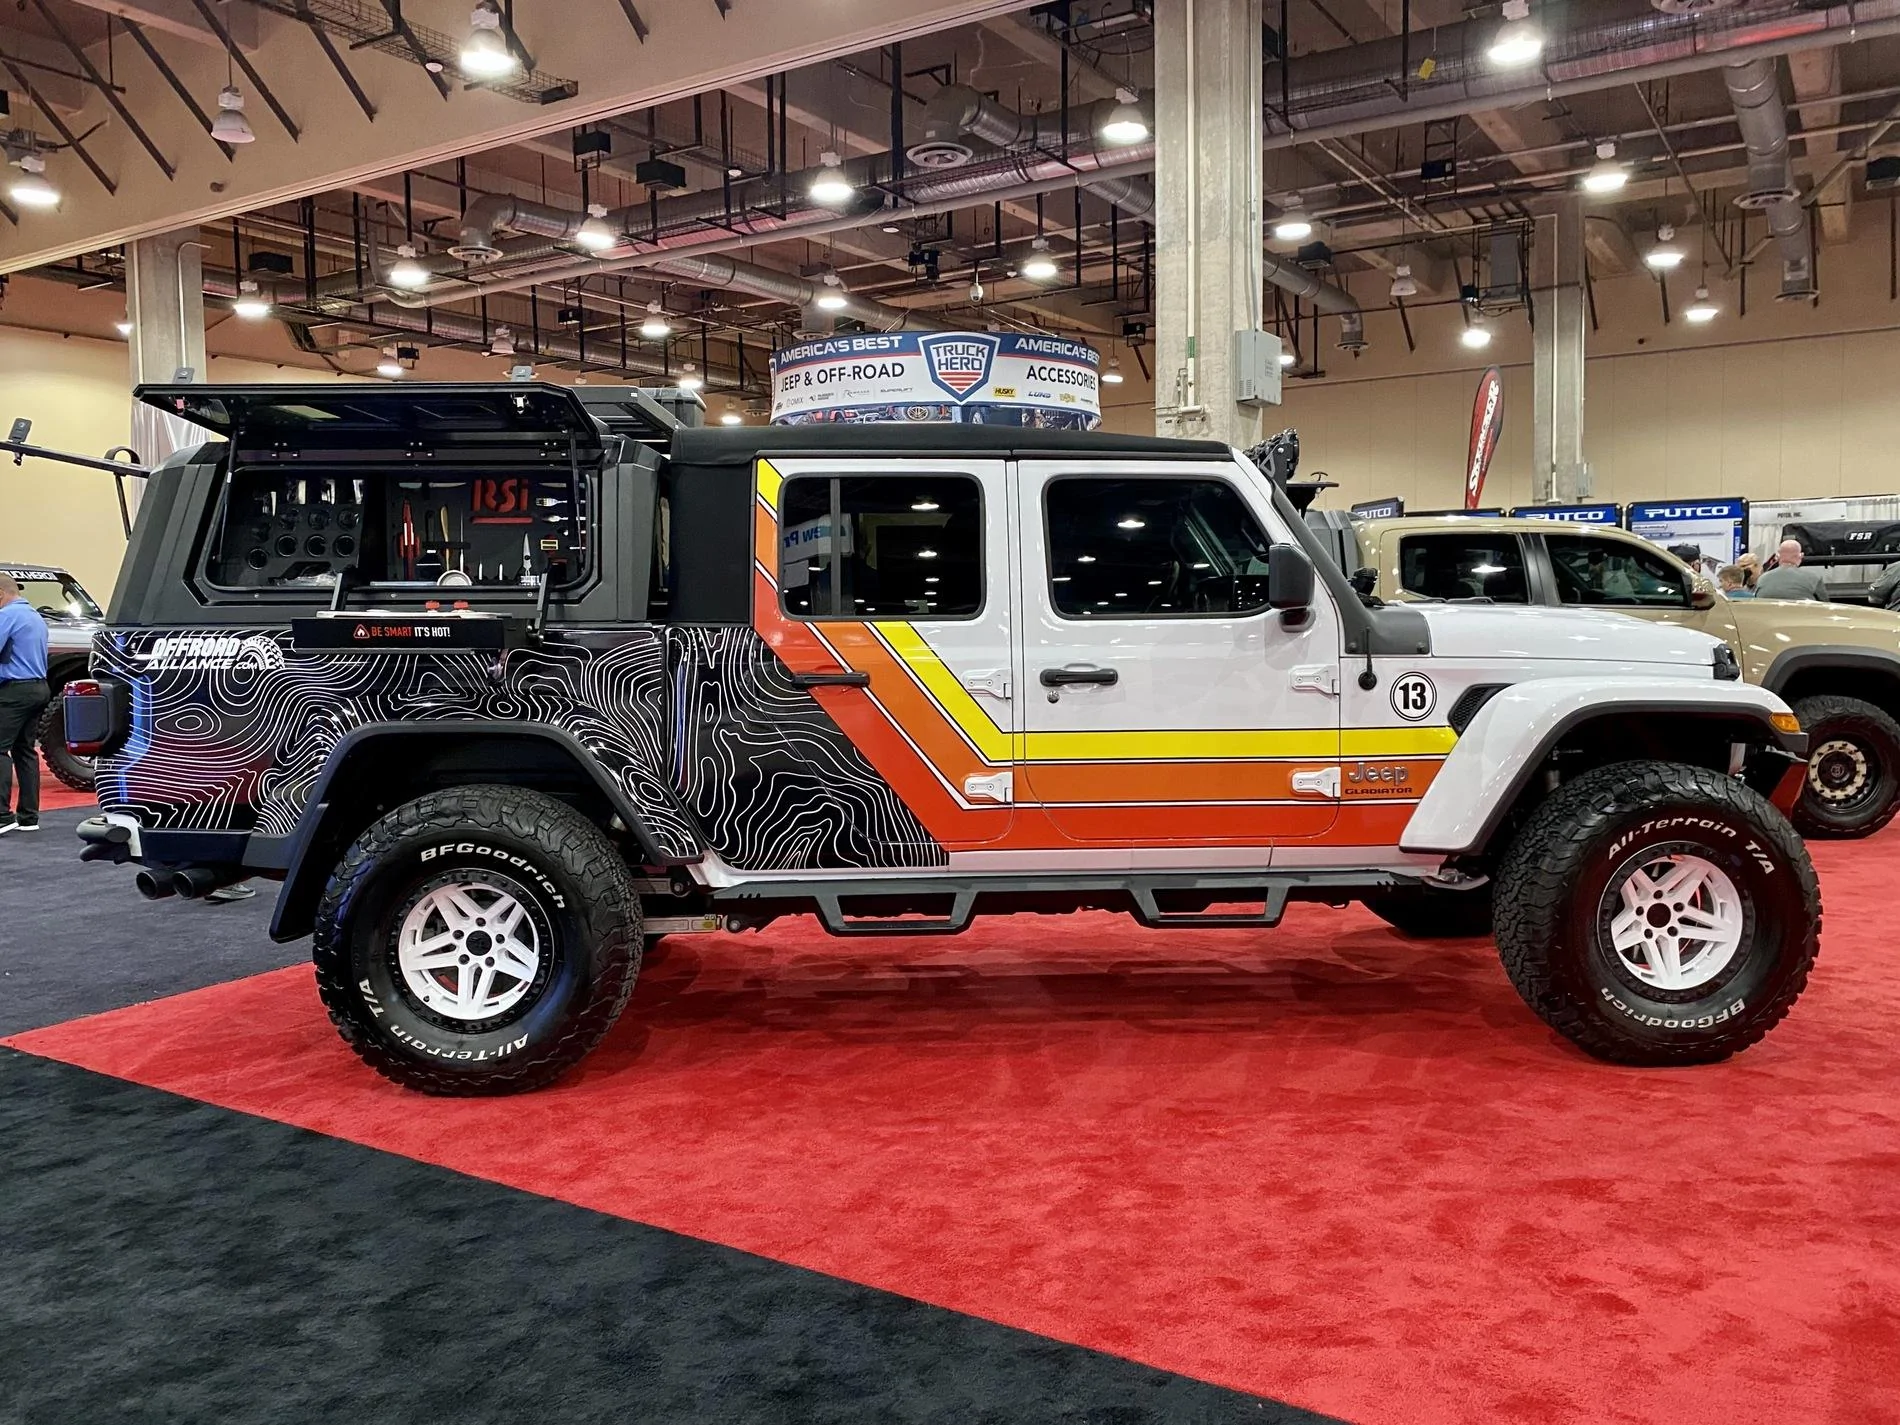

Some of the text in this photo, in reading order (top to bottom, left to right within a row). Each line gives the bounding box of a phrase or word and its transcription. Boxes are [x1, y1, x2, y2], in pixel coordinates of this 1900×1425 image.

[780, 336, 902, 365] AMERICA'S BEST
[932, 343, 987, 358] TRUCK
[1015, 338, 1088, 359] AMERICA'S
[938, 357, 982, 371] HERO
[780, 363, 905, 393] JEEP & OFF-ROAD
[1026, 365, 1096, 391] ACCESSORIES
[994, 388, 1015, 396] HUSKY
[1644, 506, 1730, 518] PUTCO
[1848, 532, 1873, 540] FSR
[371, 626, 450, 637] BE SMART IT'S HOT!
[152, 638, 241, 657] OFFROAD
[1399, 682, 1426, 710] 13
[1348, 762, 1408, 785] Jeep
[1345, 787, 1413, 795] GLADIATOR
[1608, 816, 1776, 875] All-Terrain T/A
[420, 843, 566, 909] BFGoodrich
[1600, 987, 1746, 1029] BFGoodrich
[358, 978, 529, 1062] All-Terrain T/A
